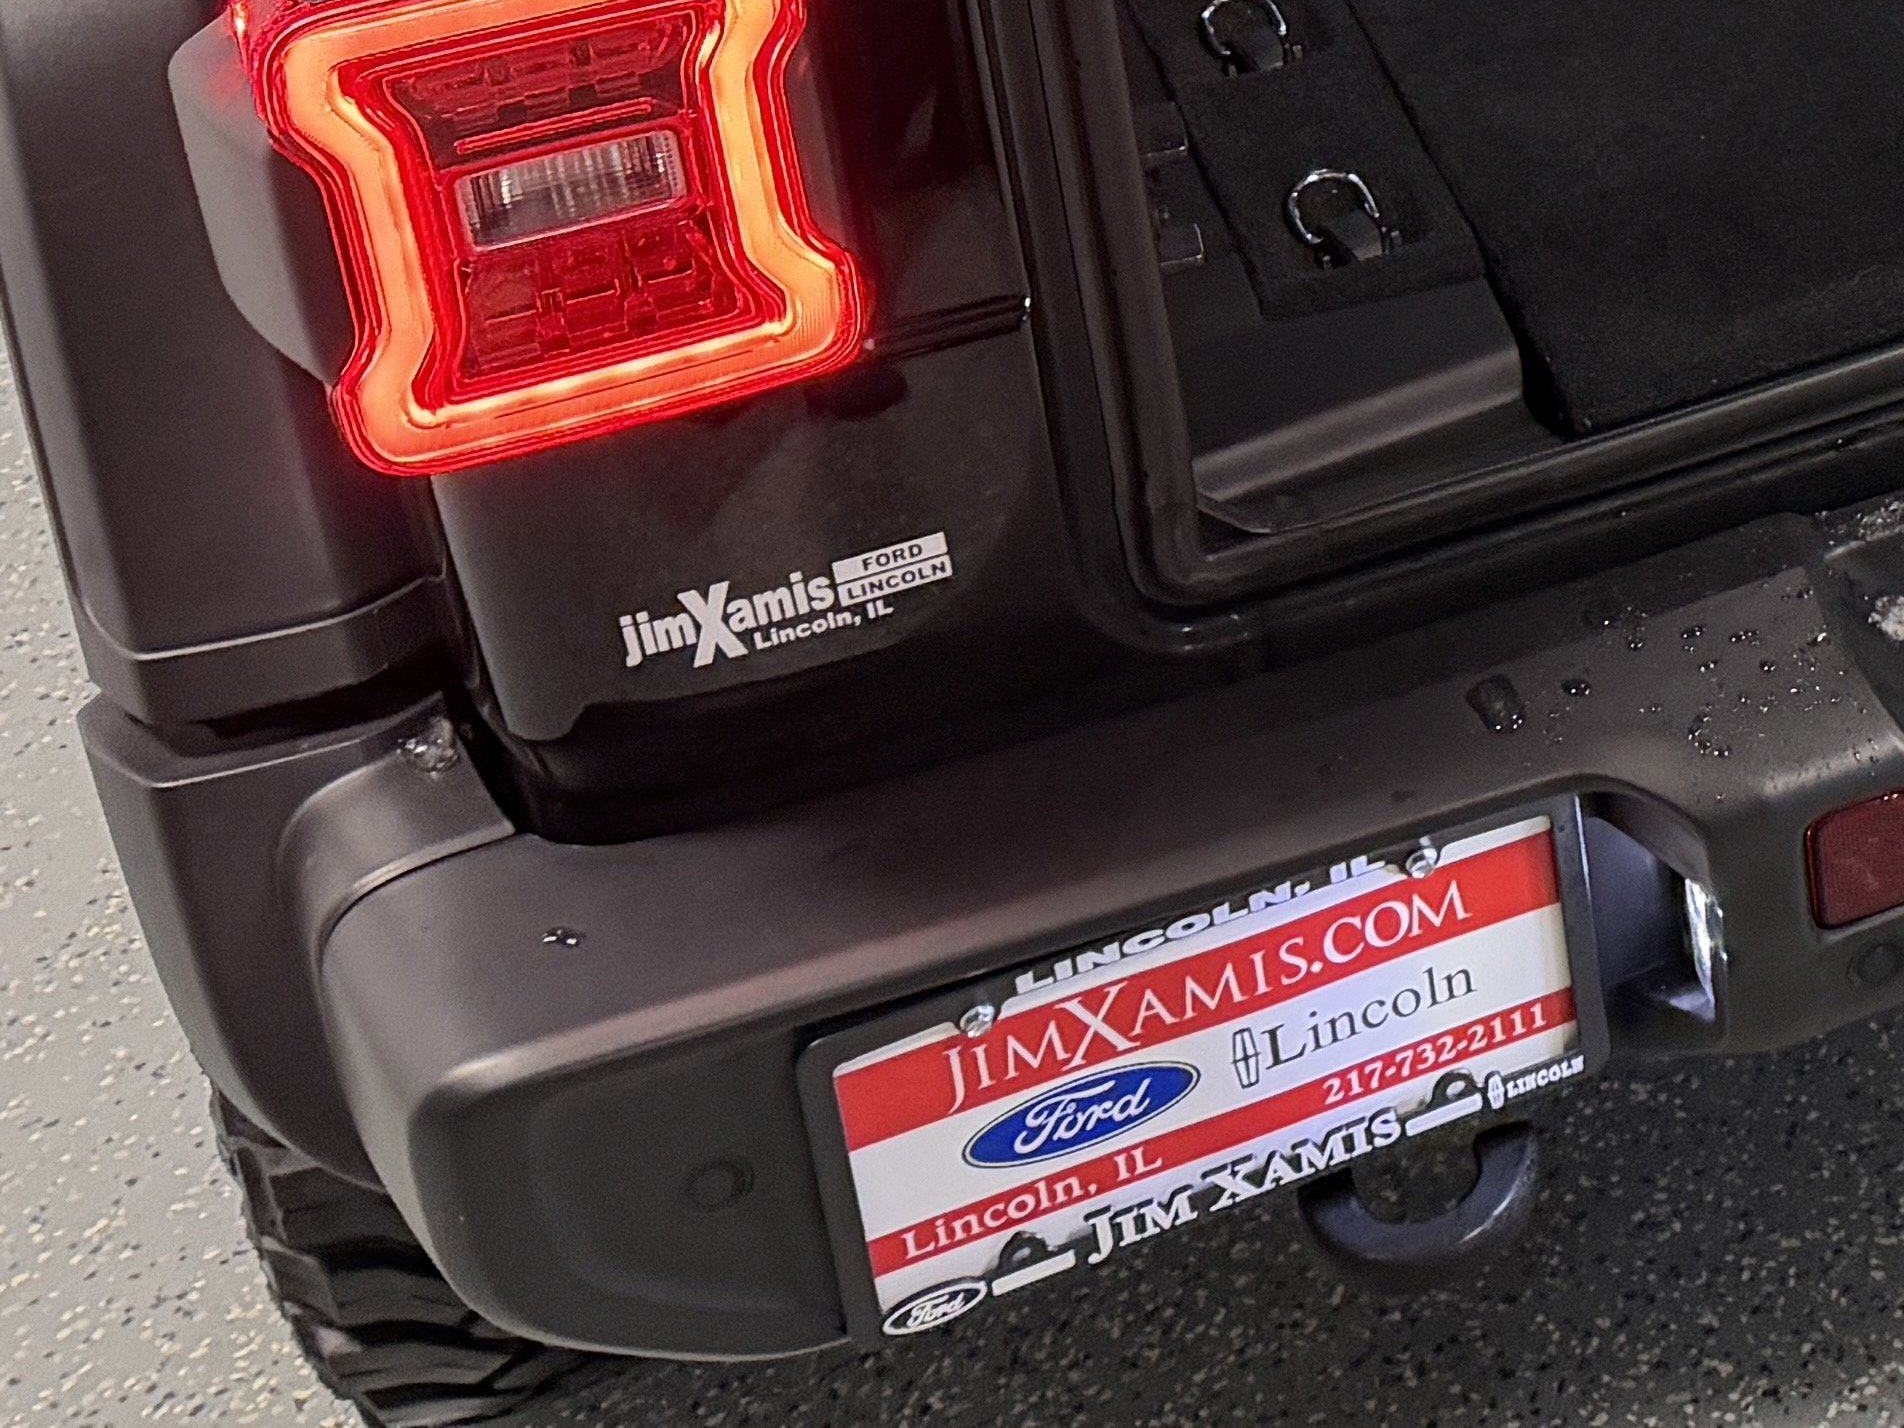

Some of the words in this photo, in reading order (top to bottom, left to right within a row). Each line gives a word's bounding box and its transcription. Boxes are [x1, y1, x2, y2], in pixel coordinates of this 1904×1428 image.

[847, 560, 947, 600] LINCOLN
[863, 543, 923, 571] FORD
[619, 570, 835, 668] jimXamis
[753, 610, 862, 651] Lincoln,
[867, 598, 895, 620] IL
[943, 880, 1472, 1114] JIMXAMIS.COM
[1261, 965, 1477, 1070] Lincoln
[1322, 1002, 1548, 1106] 217-732-2111
[1507, 1055, 1585, 1098] LINCOLN
[1014, 1077, 1152, 1155] Ford
[901, 1175, 1098, 1260] Lincoln,
[1113, 1146, 1163, 1181] IL
[1087, 1186, 1198, 1265] JIM
[1202, 1107, 1402, 1211] XAMIS
